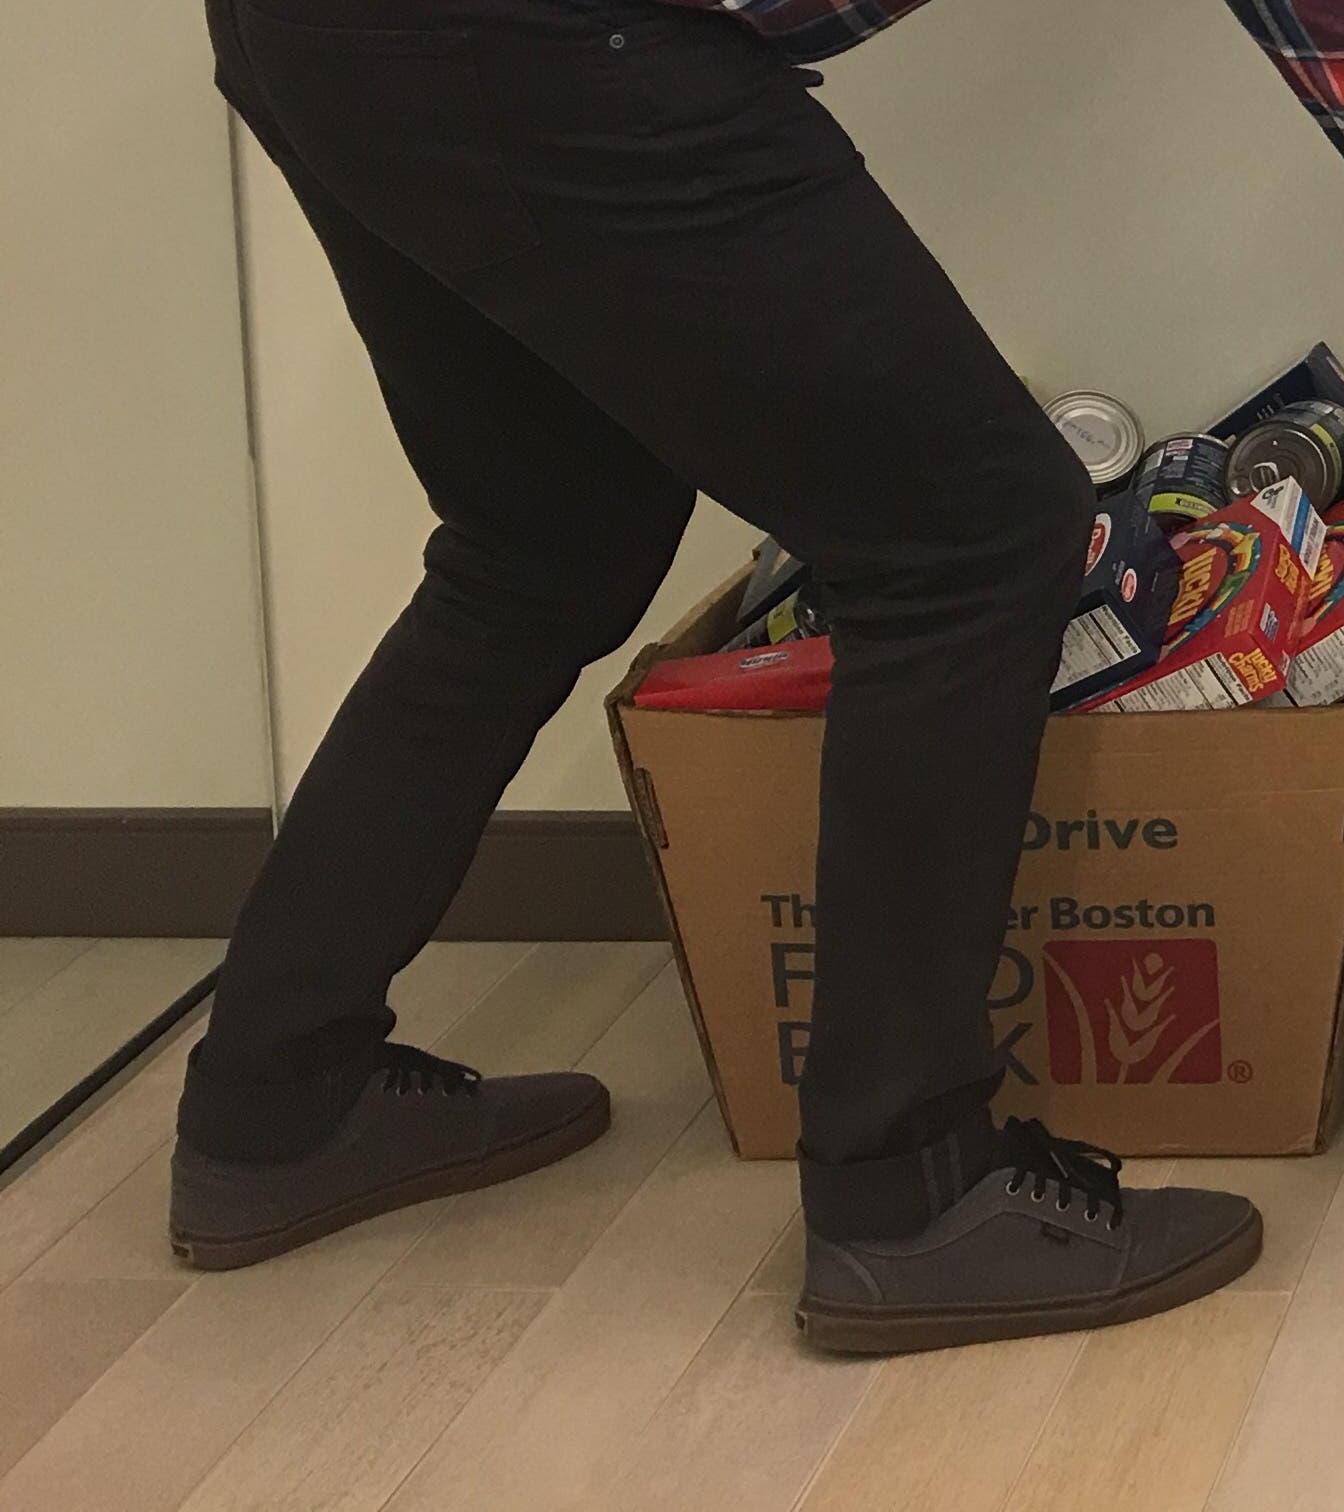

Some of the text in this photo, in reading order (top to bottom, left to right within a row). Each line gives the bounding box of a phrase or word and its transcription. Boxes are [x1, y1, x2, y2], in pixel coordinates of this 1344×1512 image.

[1228, 649, 1264, 694] Charms
[1249, 647, 1278, 685] Lucky
[1021, 809, 1178, 851] Drive
[760, 894, 816, 928] Th
[1050, 896, 1216, 930] Boston
